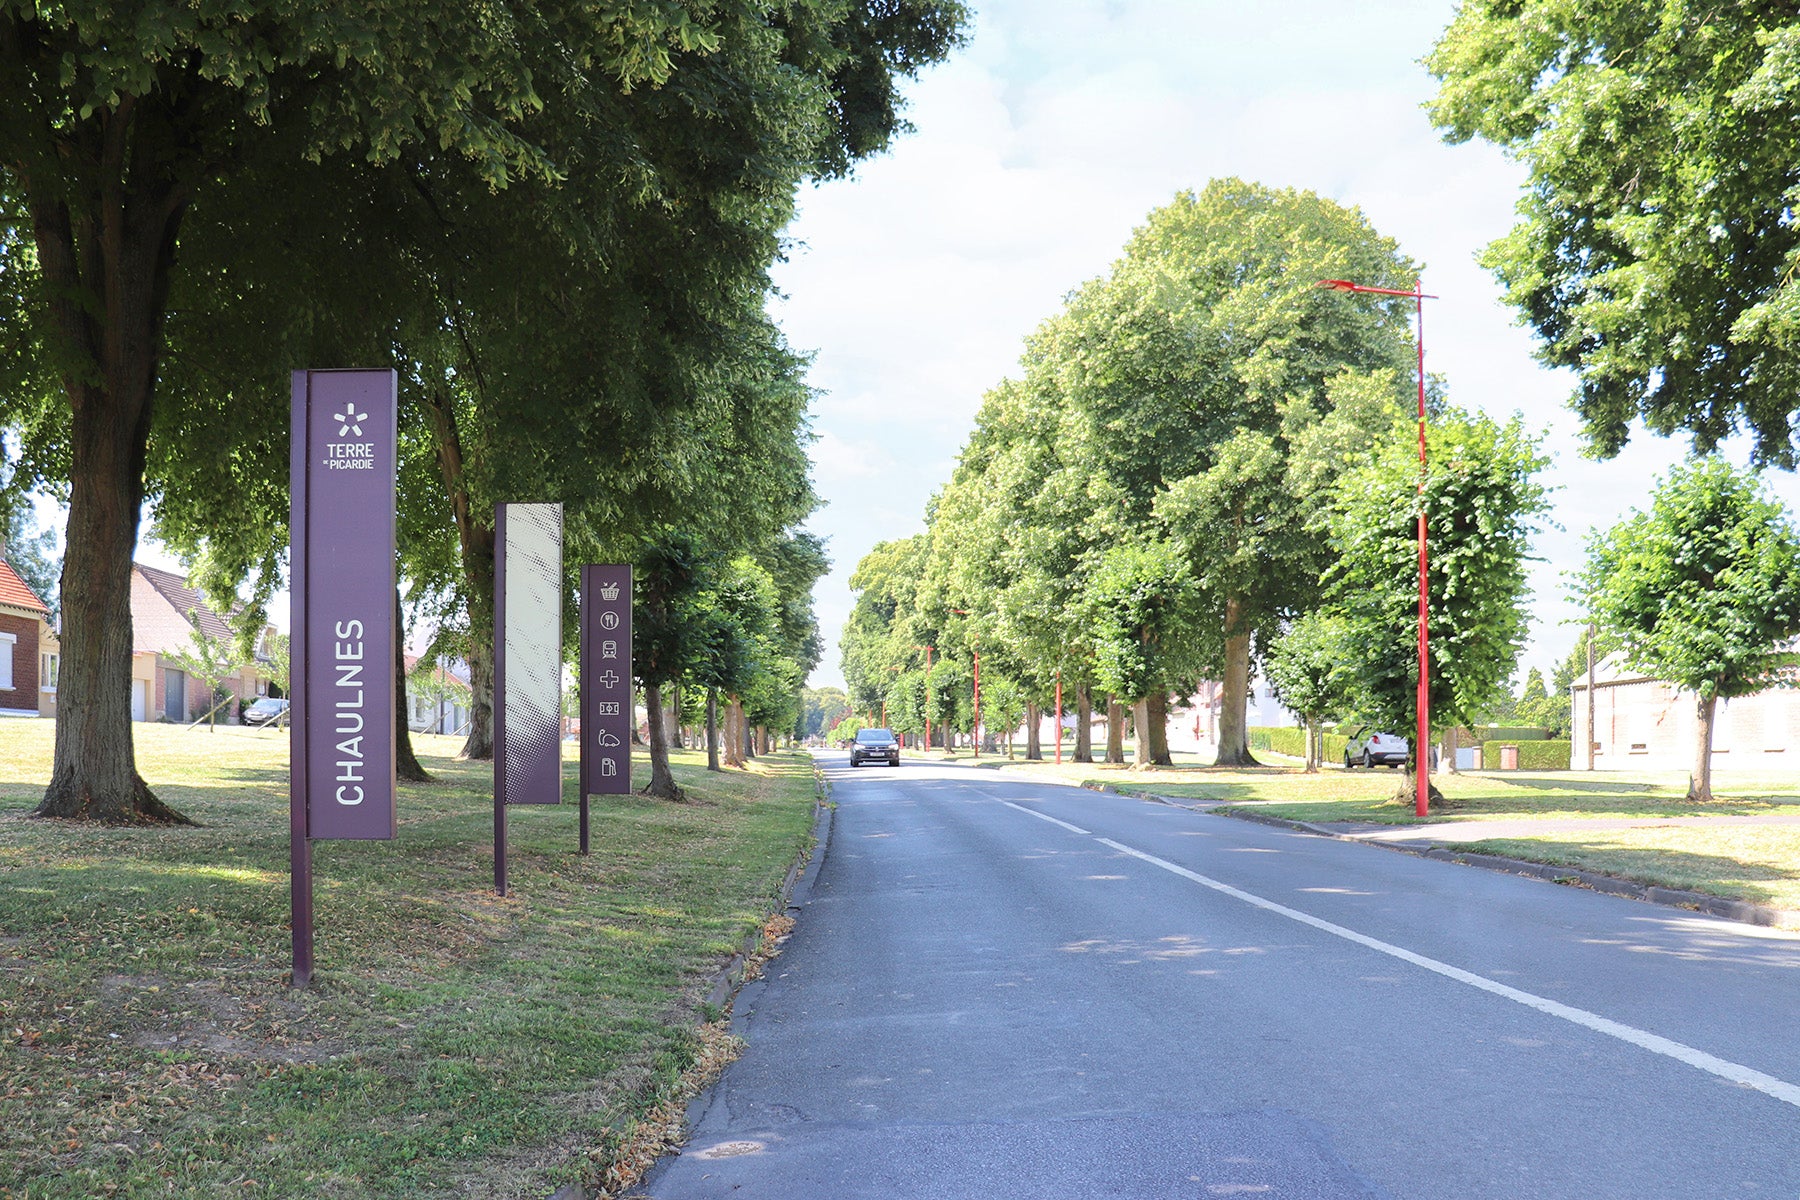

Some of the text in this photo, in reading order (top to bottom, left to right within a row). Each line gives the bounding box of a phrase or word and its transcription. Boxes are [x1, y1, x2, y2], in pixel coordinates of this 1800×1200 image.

[327, 443, 374, 458] TERRE
[329, 459, 374, 470] PICARDIE
[335, 619, 364, 806] CHAULNES
